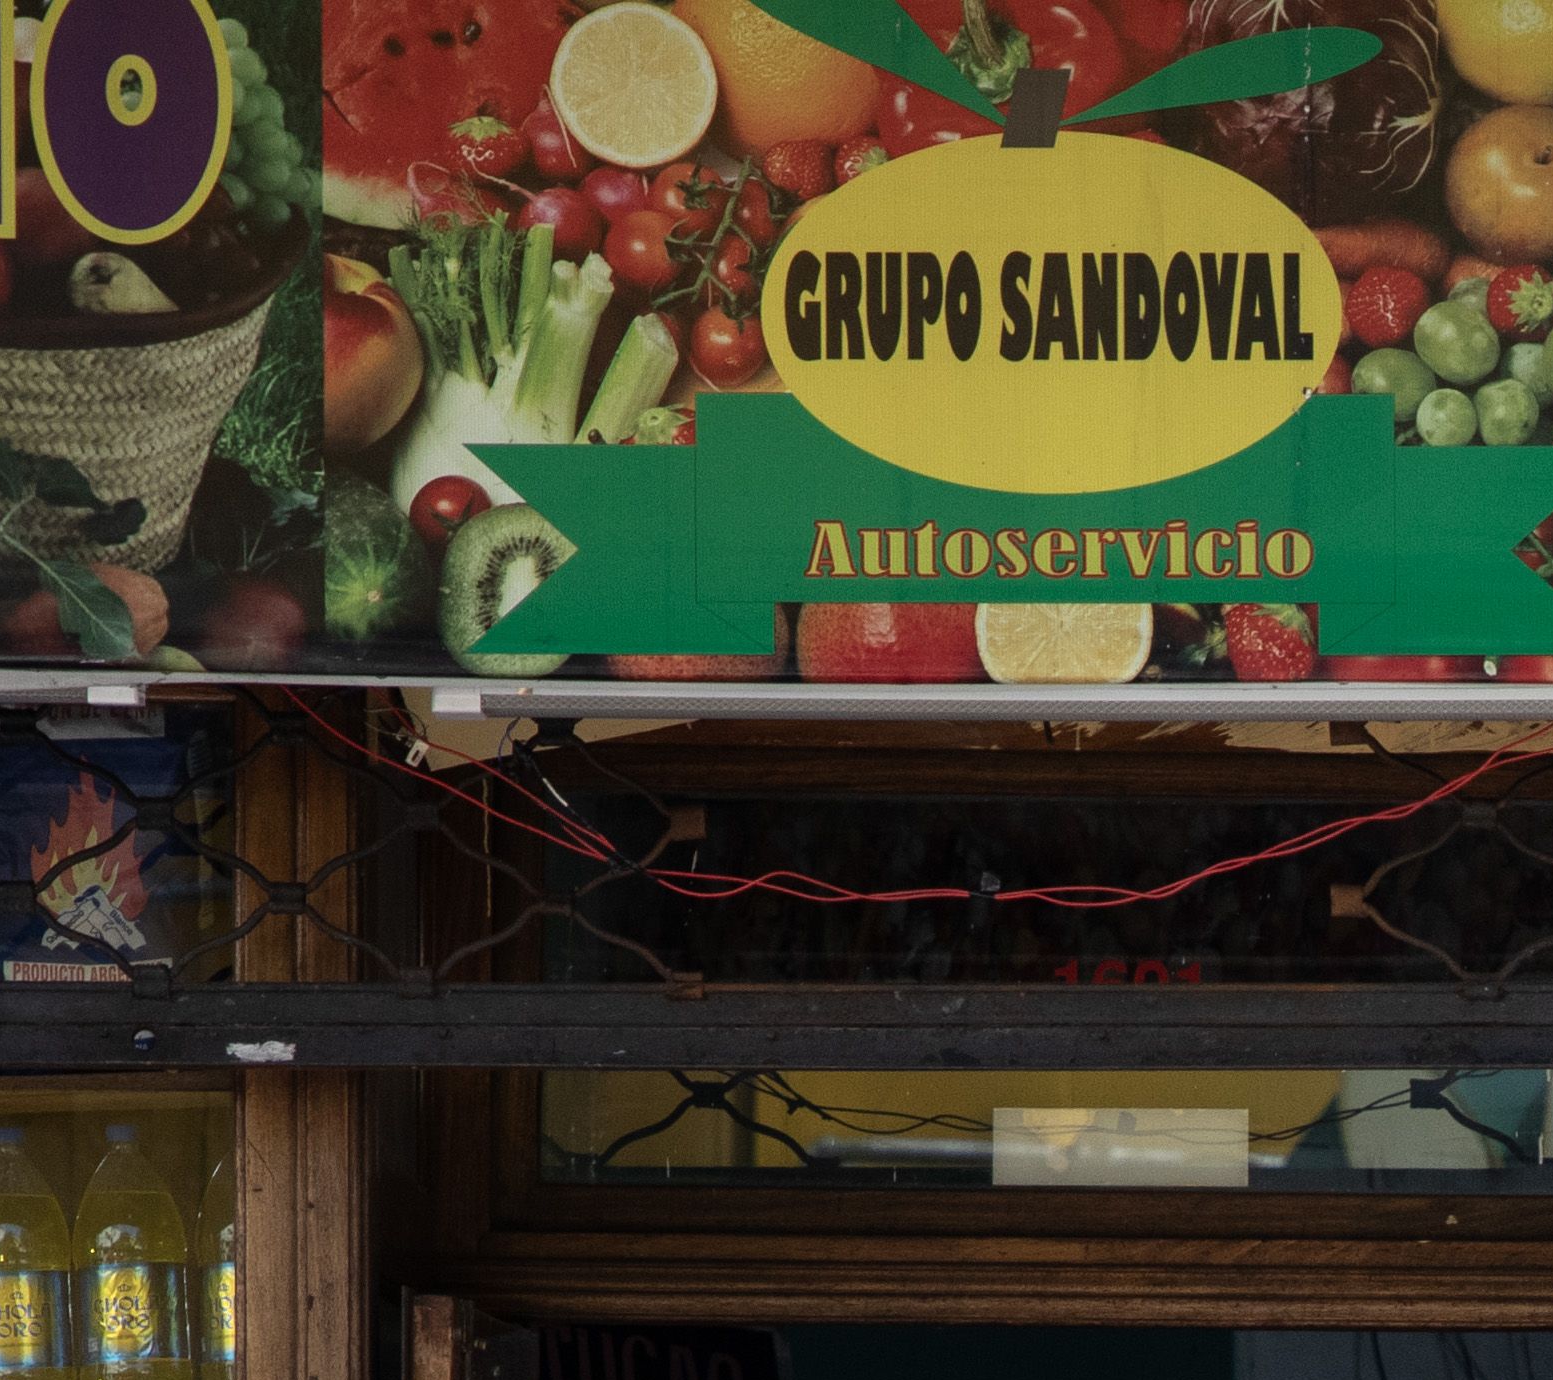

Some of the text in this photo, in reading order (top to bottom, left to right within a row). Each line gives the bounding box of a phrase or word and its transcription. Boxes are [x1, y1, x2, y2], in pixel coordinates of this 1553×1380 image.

[783, 250, 1314, 363] GRUPO SANDOVAL
[805, 518, 1315, 581] Autoservicio
